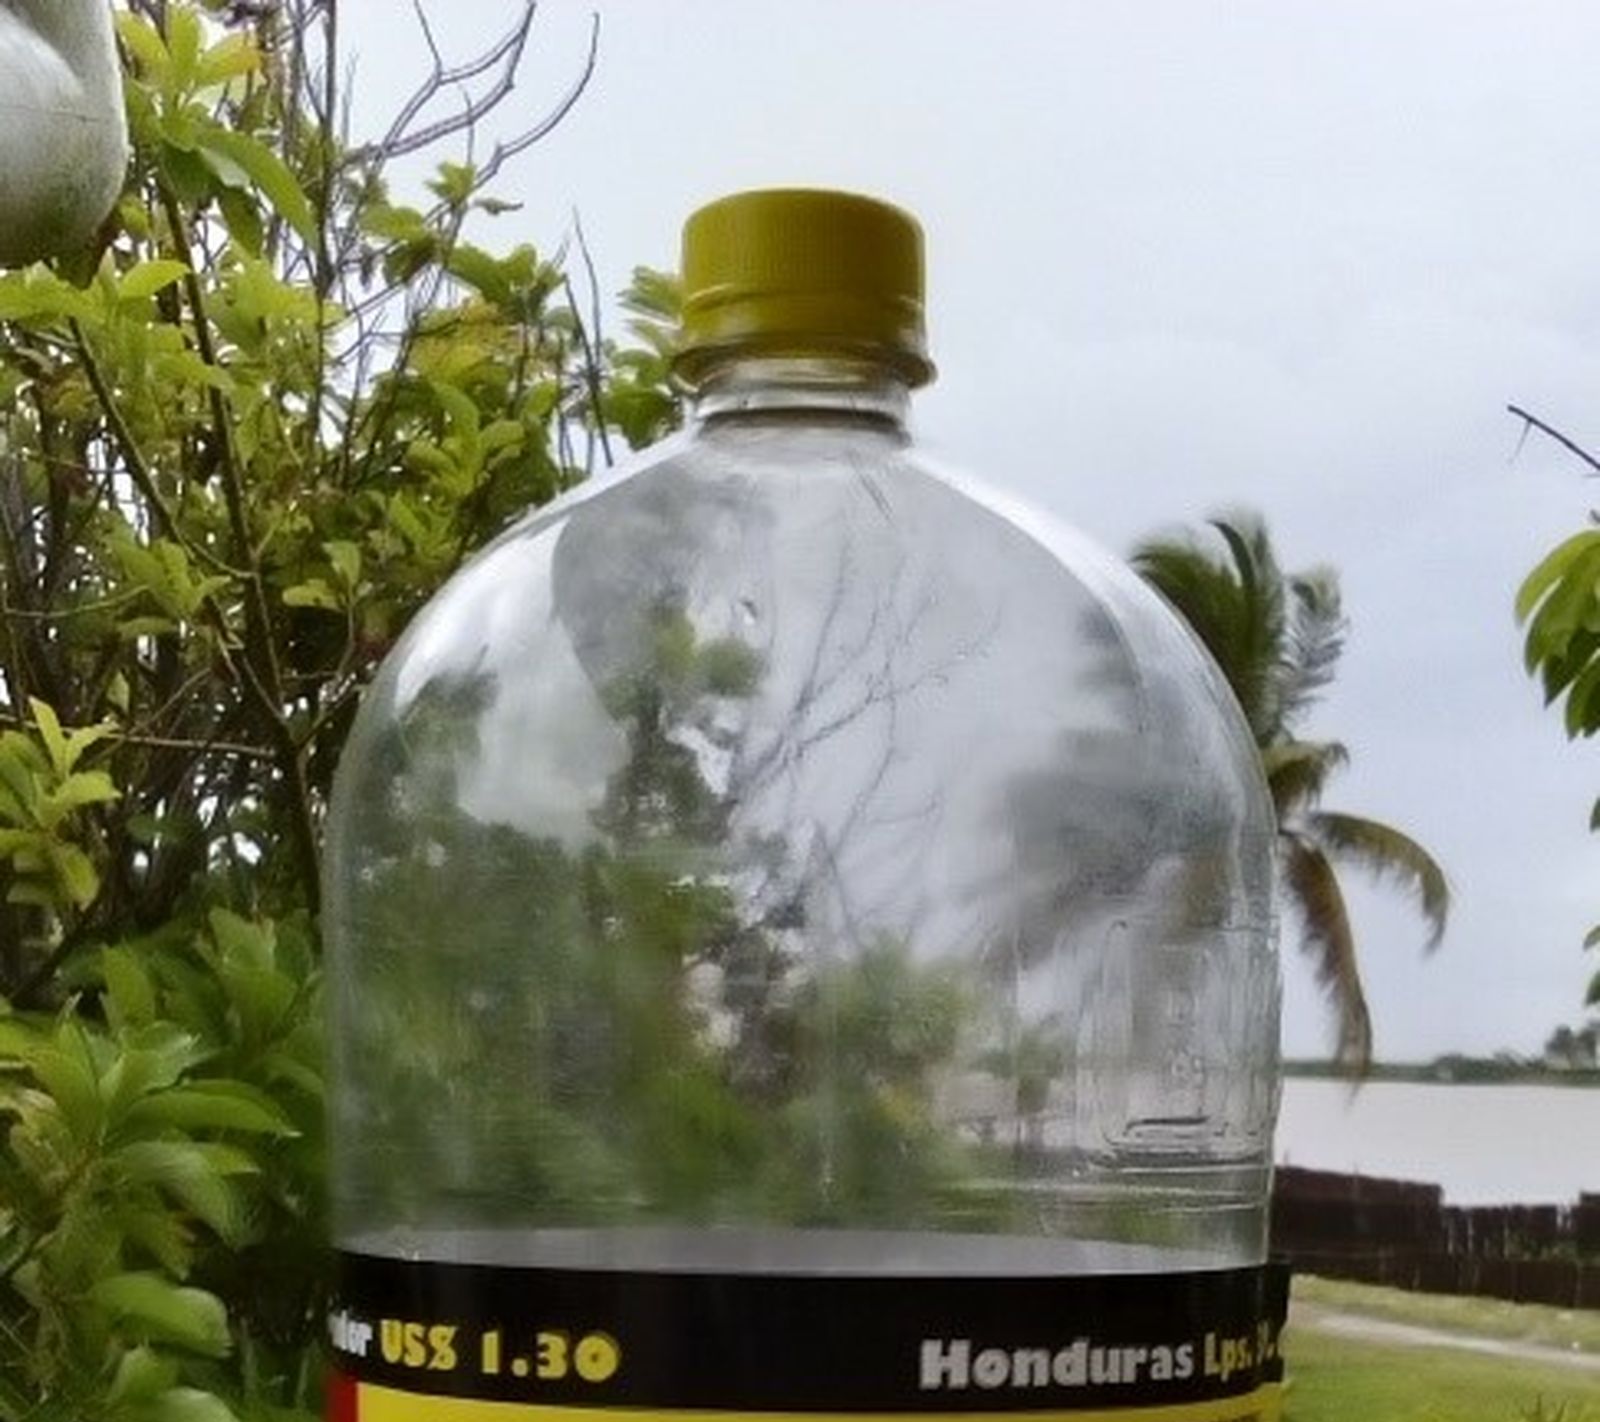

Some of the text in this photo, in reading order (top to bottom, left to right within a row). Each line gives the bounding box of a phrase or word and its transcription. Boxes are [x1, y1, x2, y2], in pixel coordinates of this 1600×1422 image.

[379, 1319, 458, 1371] US$
[482, 1331, 619, 1382] 1.30
[918, 1338, 1195, 1391] Honduras
